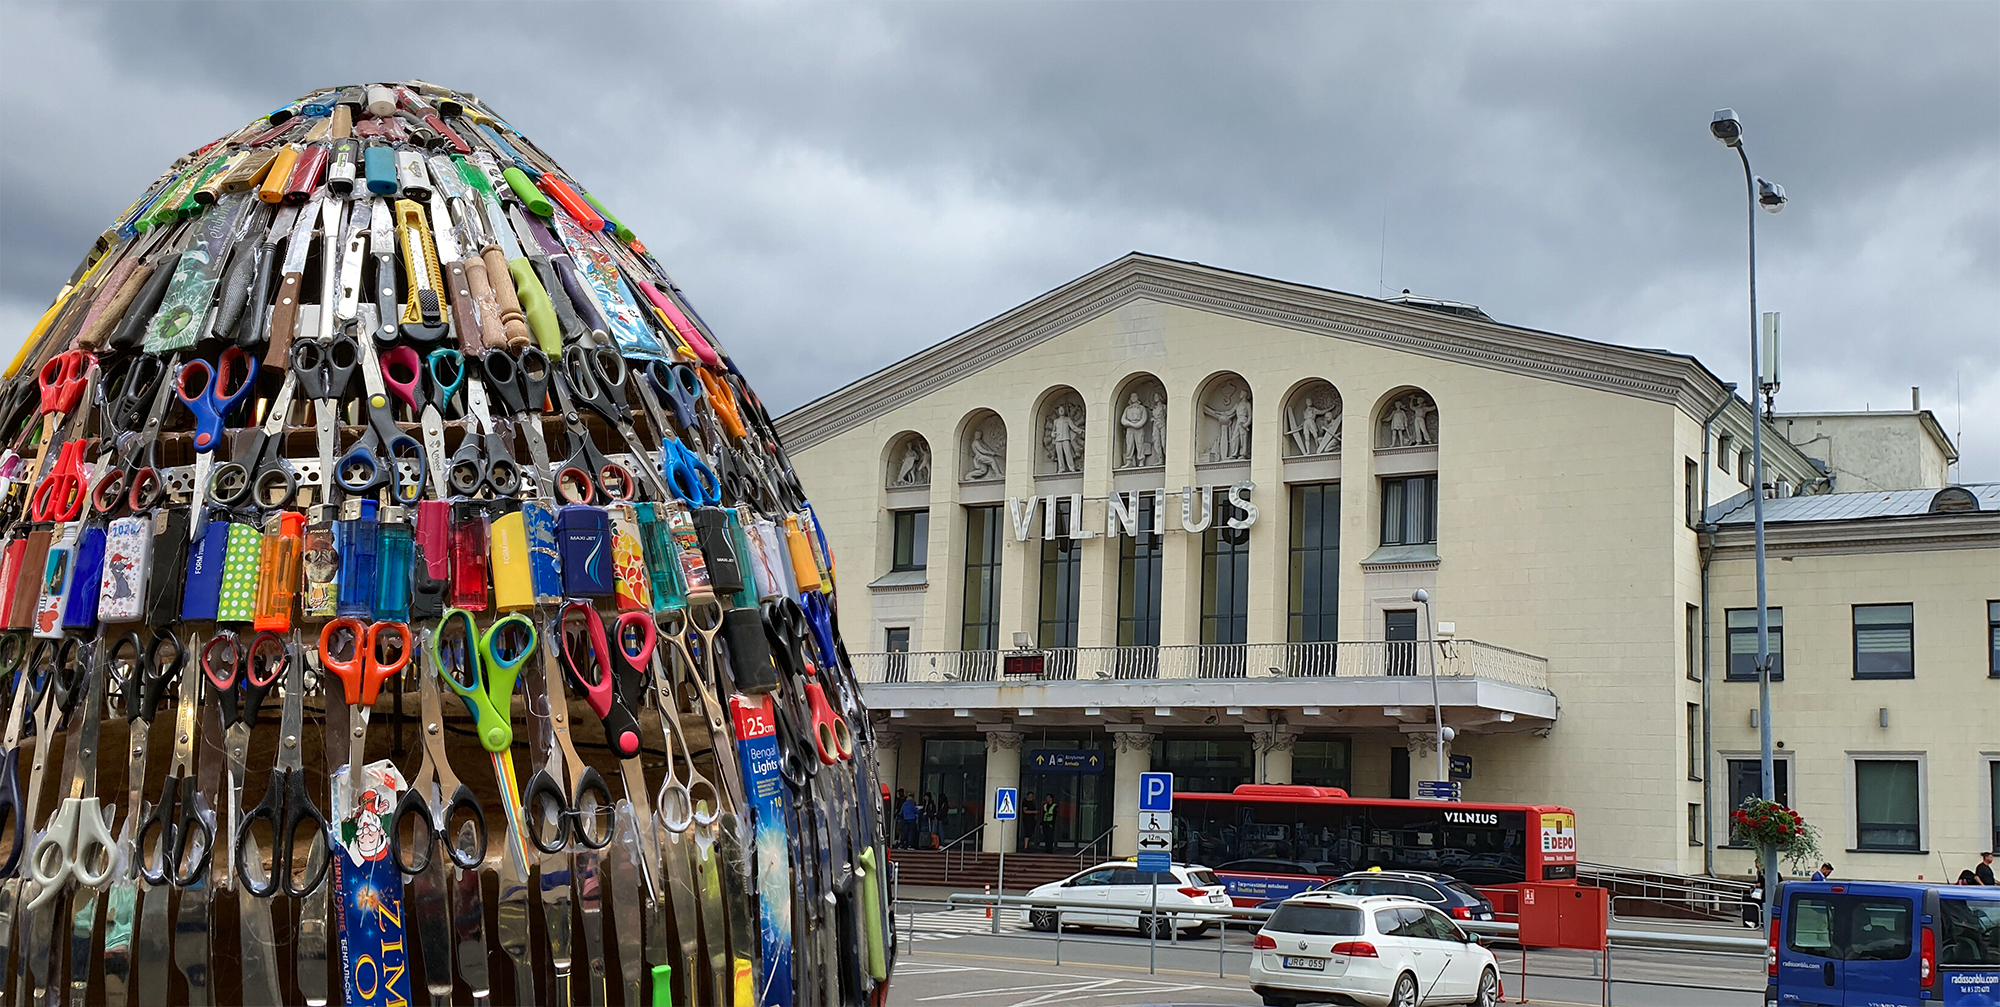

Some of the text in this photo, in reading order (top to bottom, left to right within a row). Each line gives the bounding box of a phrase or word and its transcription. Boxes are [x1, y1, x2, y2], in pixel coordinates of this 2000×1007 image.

[1010, 479, 1259, 542] VILNIUS
[502, 546, 511, 565] FORM
[195, 555, 204, 575] FORM
[750, 743, 776, 762] Bengal
[1049, 754, 1056, 766] A
[752, 759, 778, 776] Lights
[1147, 777, 1165, 806] P
[774, 796, 783, 809] 10
[1444, 811, 1498, 824] VILNIUS
[1551, 836, 1573, 849] DEPO
[333, 856, 346, 932] ZIMNE OGNIE
[1288, 958, 1323, 969] JRG 055
[1782, 961, 1820, 969] radissonblu.com
[1951, 973, 1999, 984] radissonblu.com
